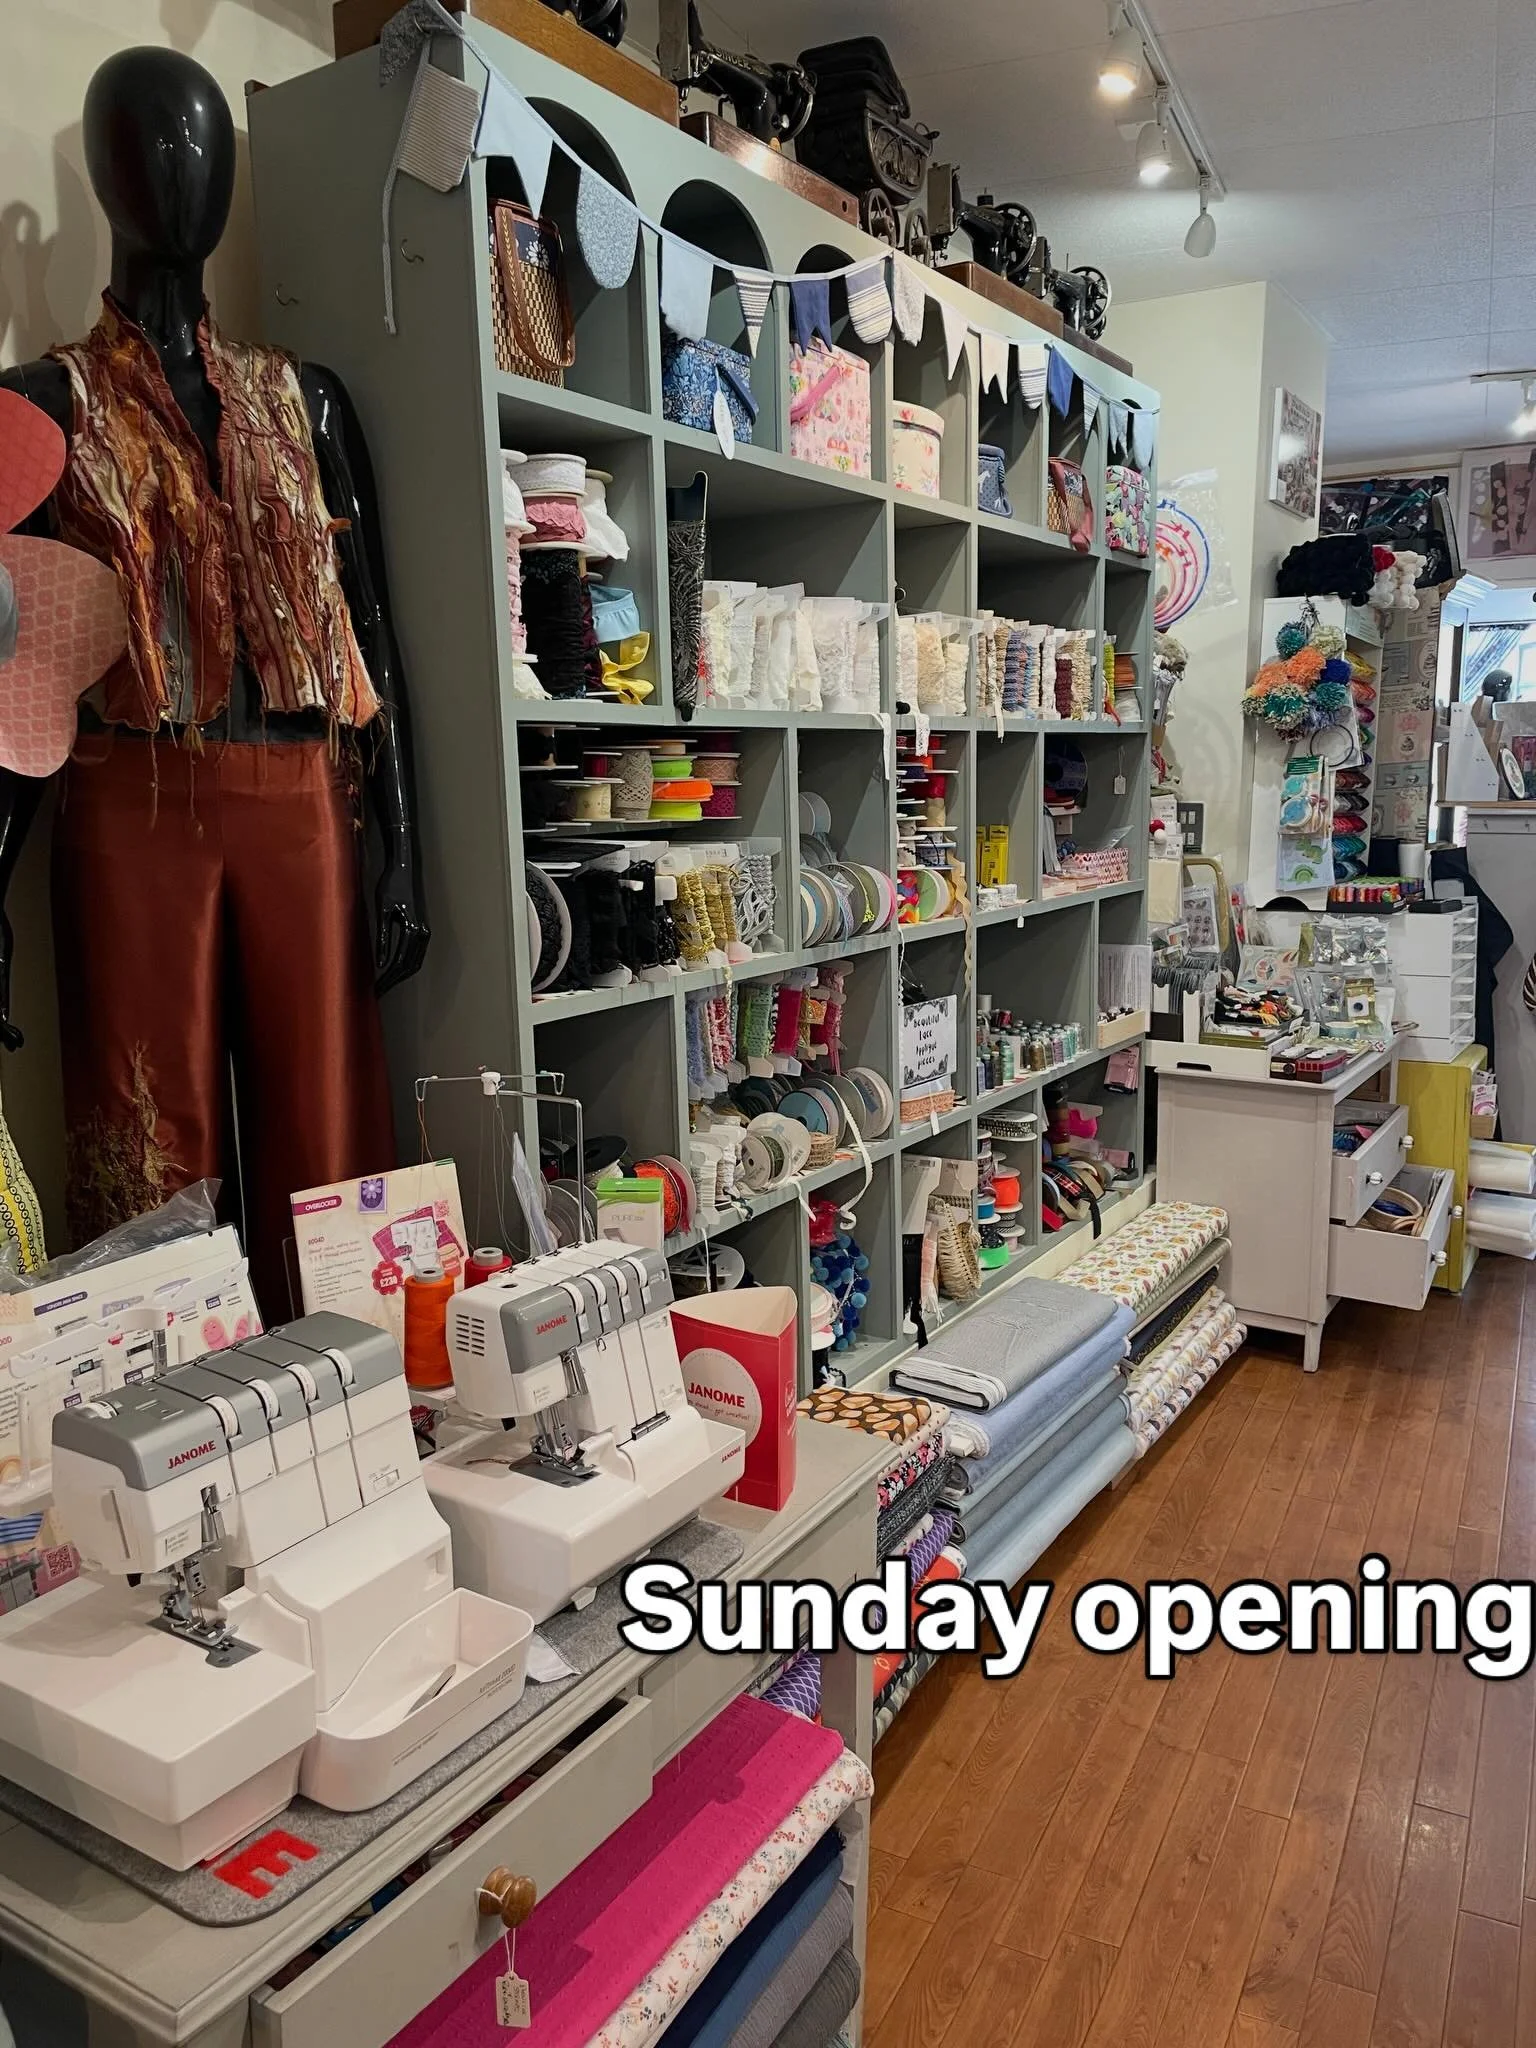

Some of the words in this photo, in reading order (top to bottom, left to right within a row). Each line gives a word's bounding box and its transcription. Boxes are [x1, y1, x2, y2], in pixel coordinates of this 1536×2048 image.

[535, 1315, 568, 1335] JANOME
[687, 1382, 746, 1408] JANOME
[168, 1440, 217, 1469] JANOME
[721, 1446, 742, 1464] JANOME
